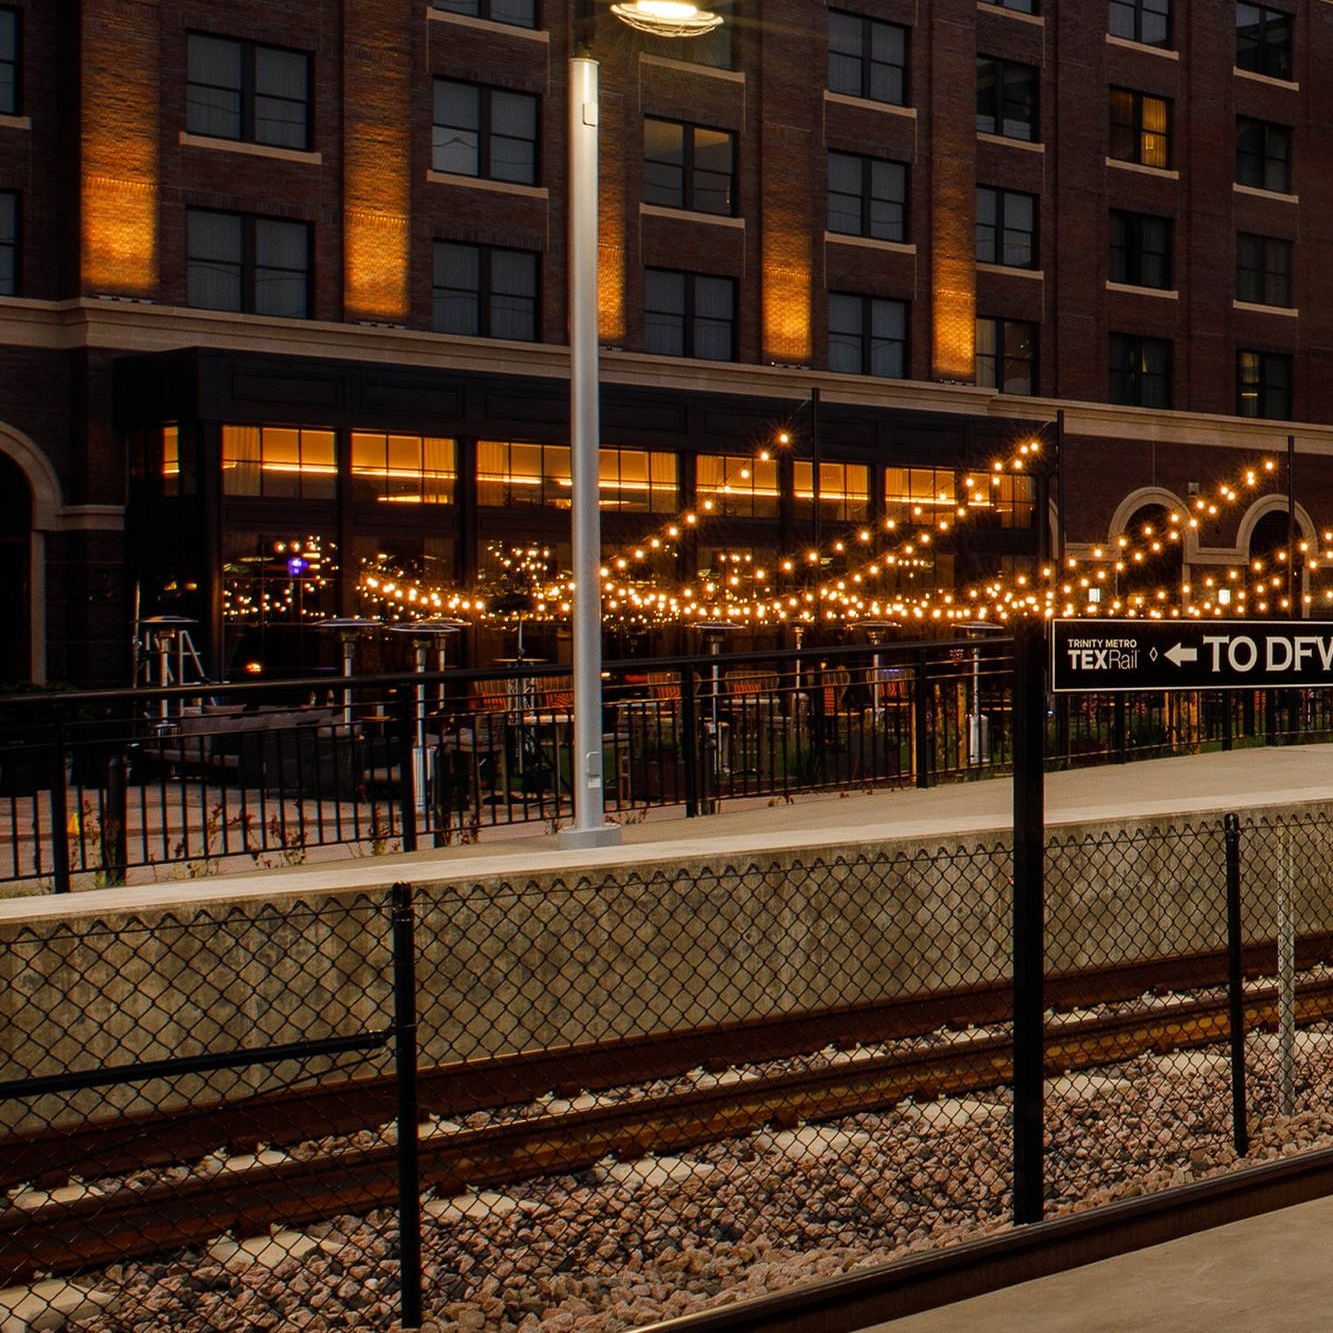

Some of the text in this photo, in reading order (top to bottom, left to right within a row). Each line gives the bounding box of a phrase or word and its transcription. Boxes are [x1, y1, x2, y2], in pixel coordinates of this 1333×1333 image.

[1067, 639, 1137, 648] TRINITY METRO
[1203, 635, 1257, 672] TO
